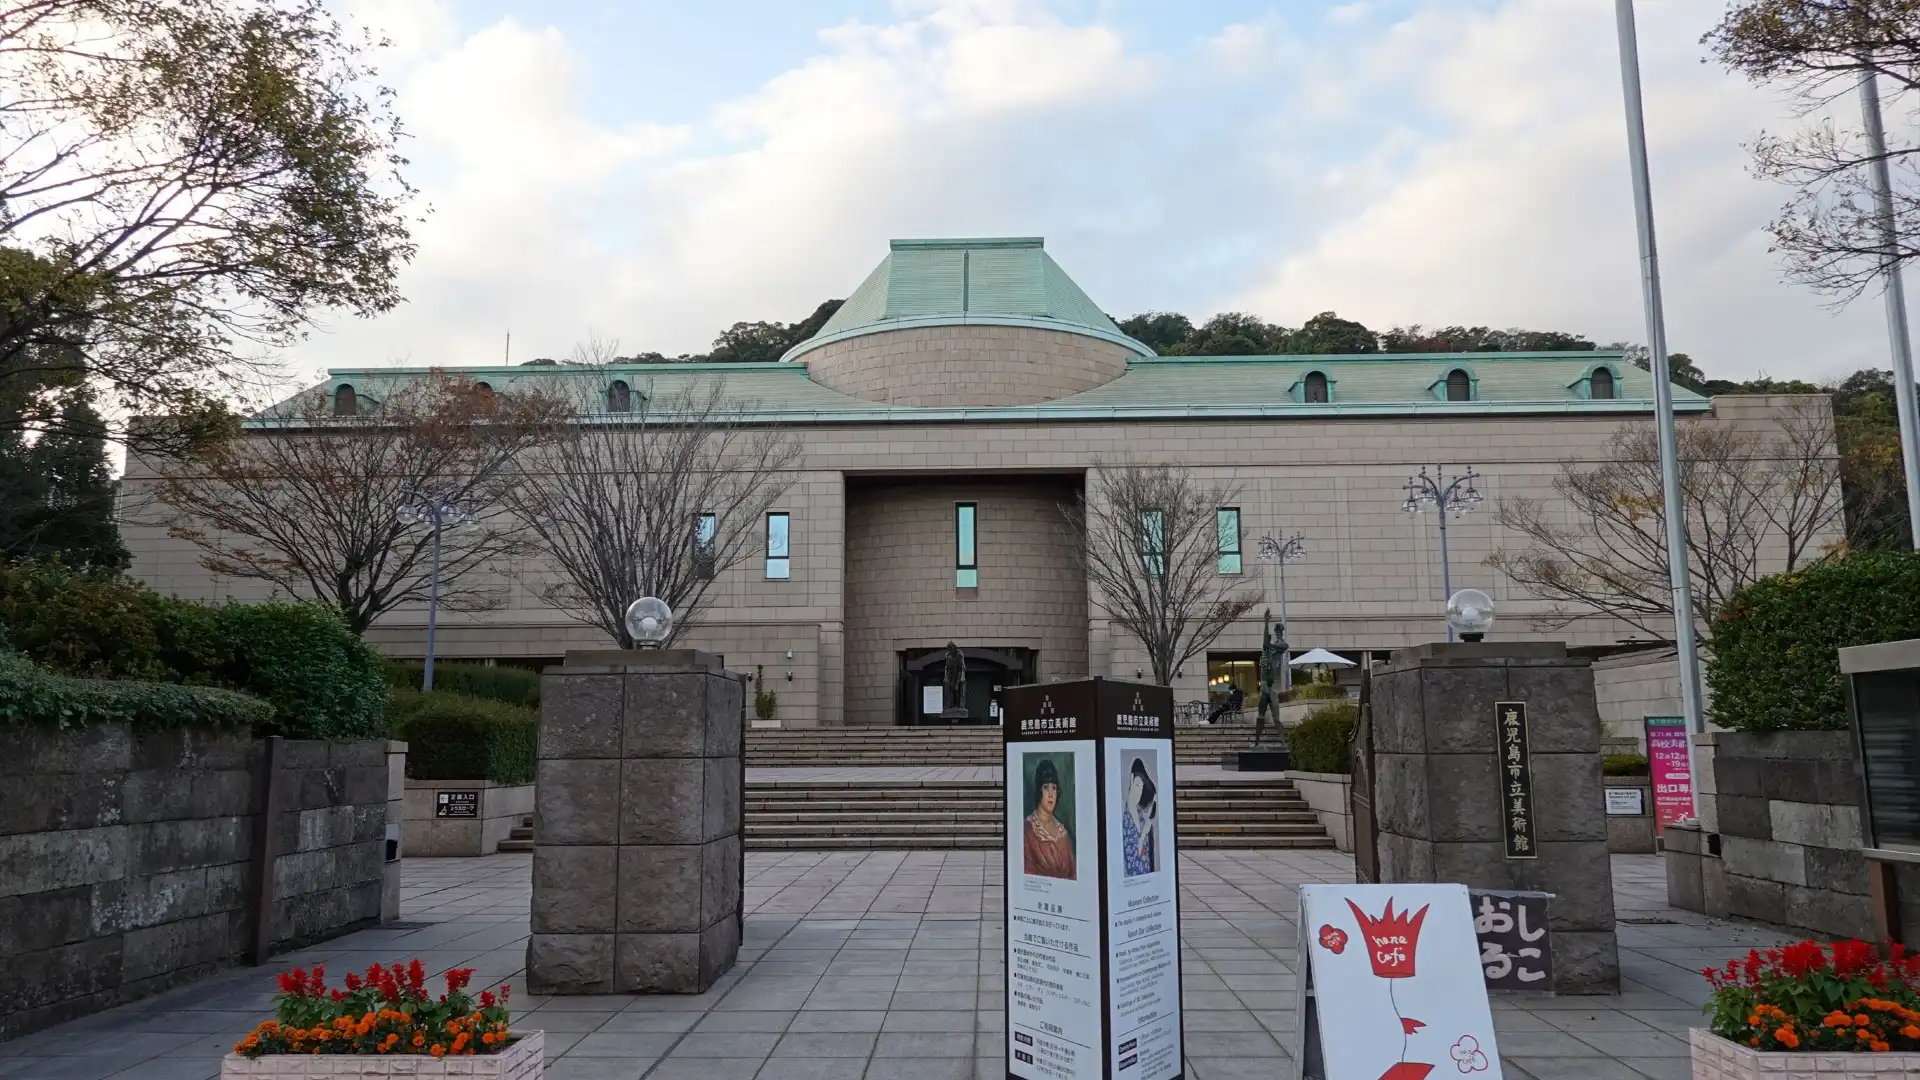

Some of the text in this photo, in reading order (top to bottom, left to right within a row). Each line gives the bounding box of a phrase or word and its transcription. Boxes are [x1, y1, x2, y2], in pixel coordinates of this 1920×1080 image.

[1021, 717, 1076, 730] 鹿児島市立美術館
[1117, 714, 1159, 726] 鹿児島市立美術館
[1503, 708, 1529, 852] 鹿児島市立美術館
[1656, 783, 1692, 793] 出口専
